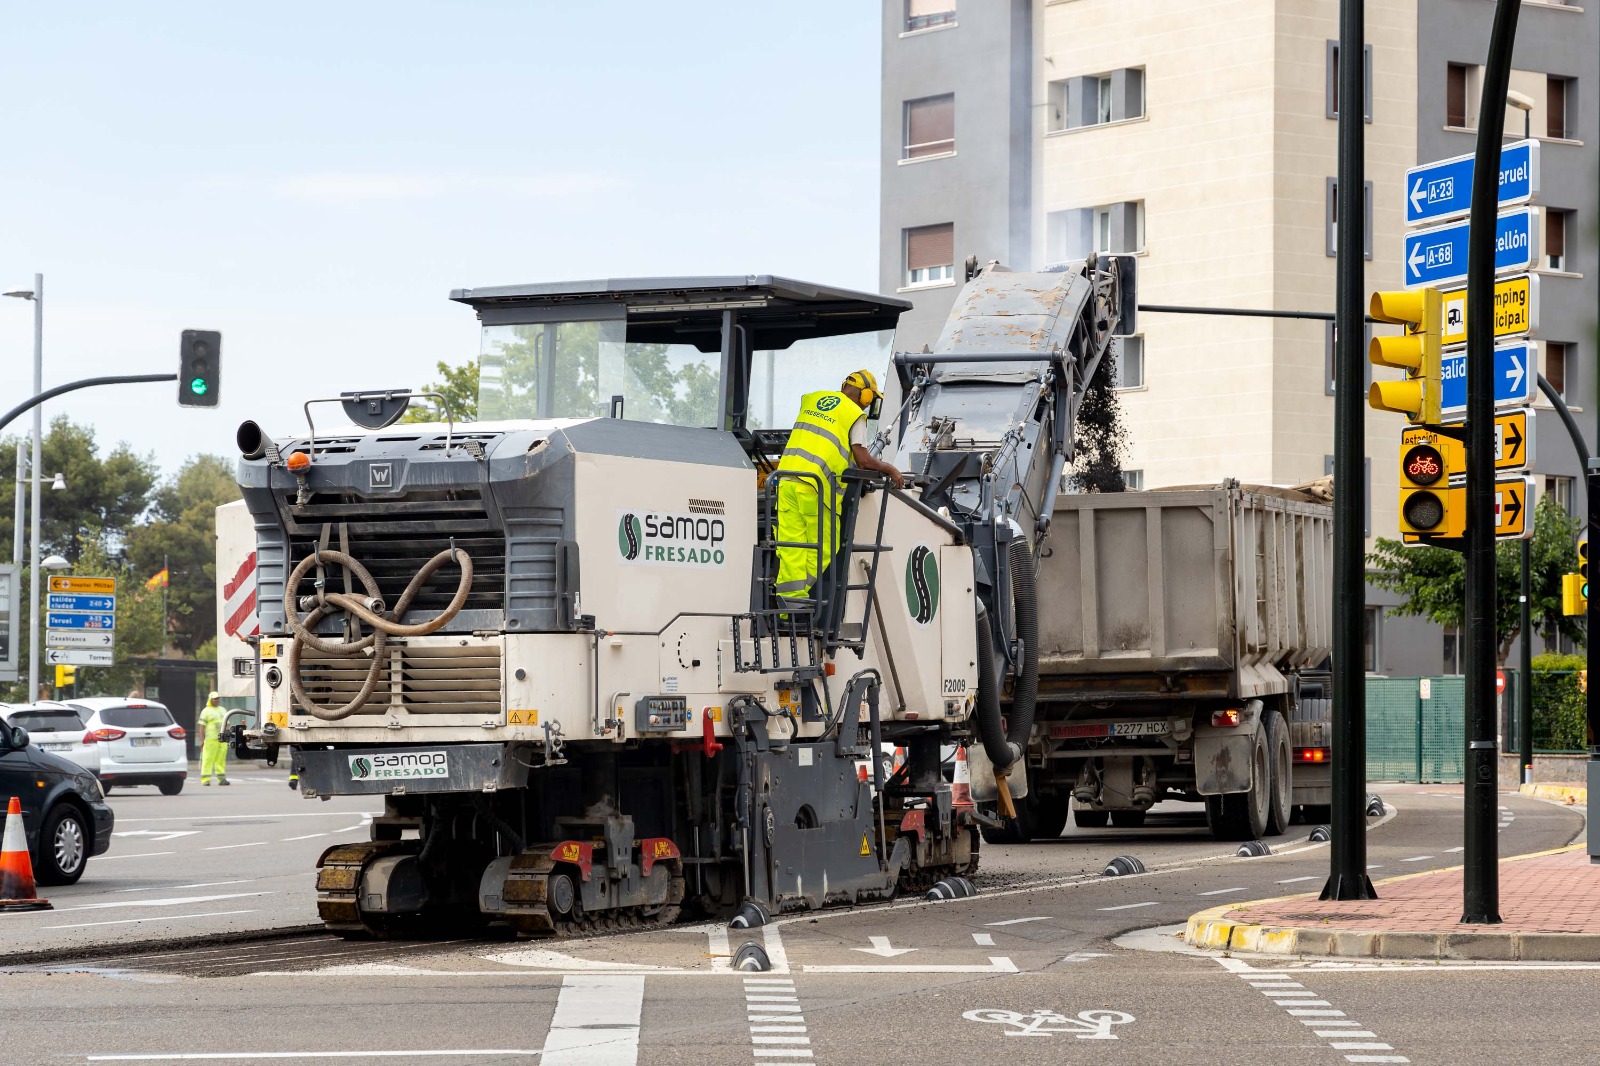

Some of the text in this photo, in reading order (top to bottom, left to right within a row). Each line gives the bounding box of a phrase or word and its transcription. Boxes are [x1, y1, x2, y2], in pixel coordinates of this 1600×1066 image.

[1430, 161, 1528, 200] A-23 eruel
[1427, 229, 1527, 265] A-68 ellón
[1494, 288, 1526, 308] mping
[1495, 309, 1525, 329] icipal
[1441, 358, 1466, 381] salid
[645, 544, 725, 565] FRESADO
[51, 616, 72, 624] Teruel
[944, 679, 966, 693] F2009
[1116, 721, 1167, 734] 2277 HCX
[375, 767, 447, 777] FRESADO
